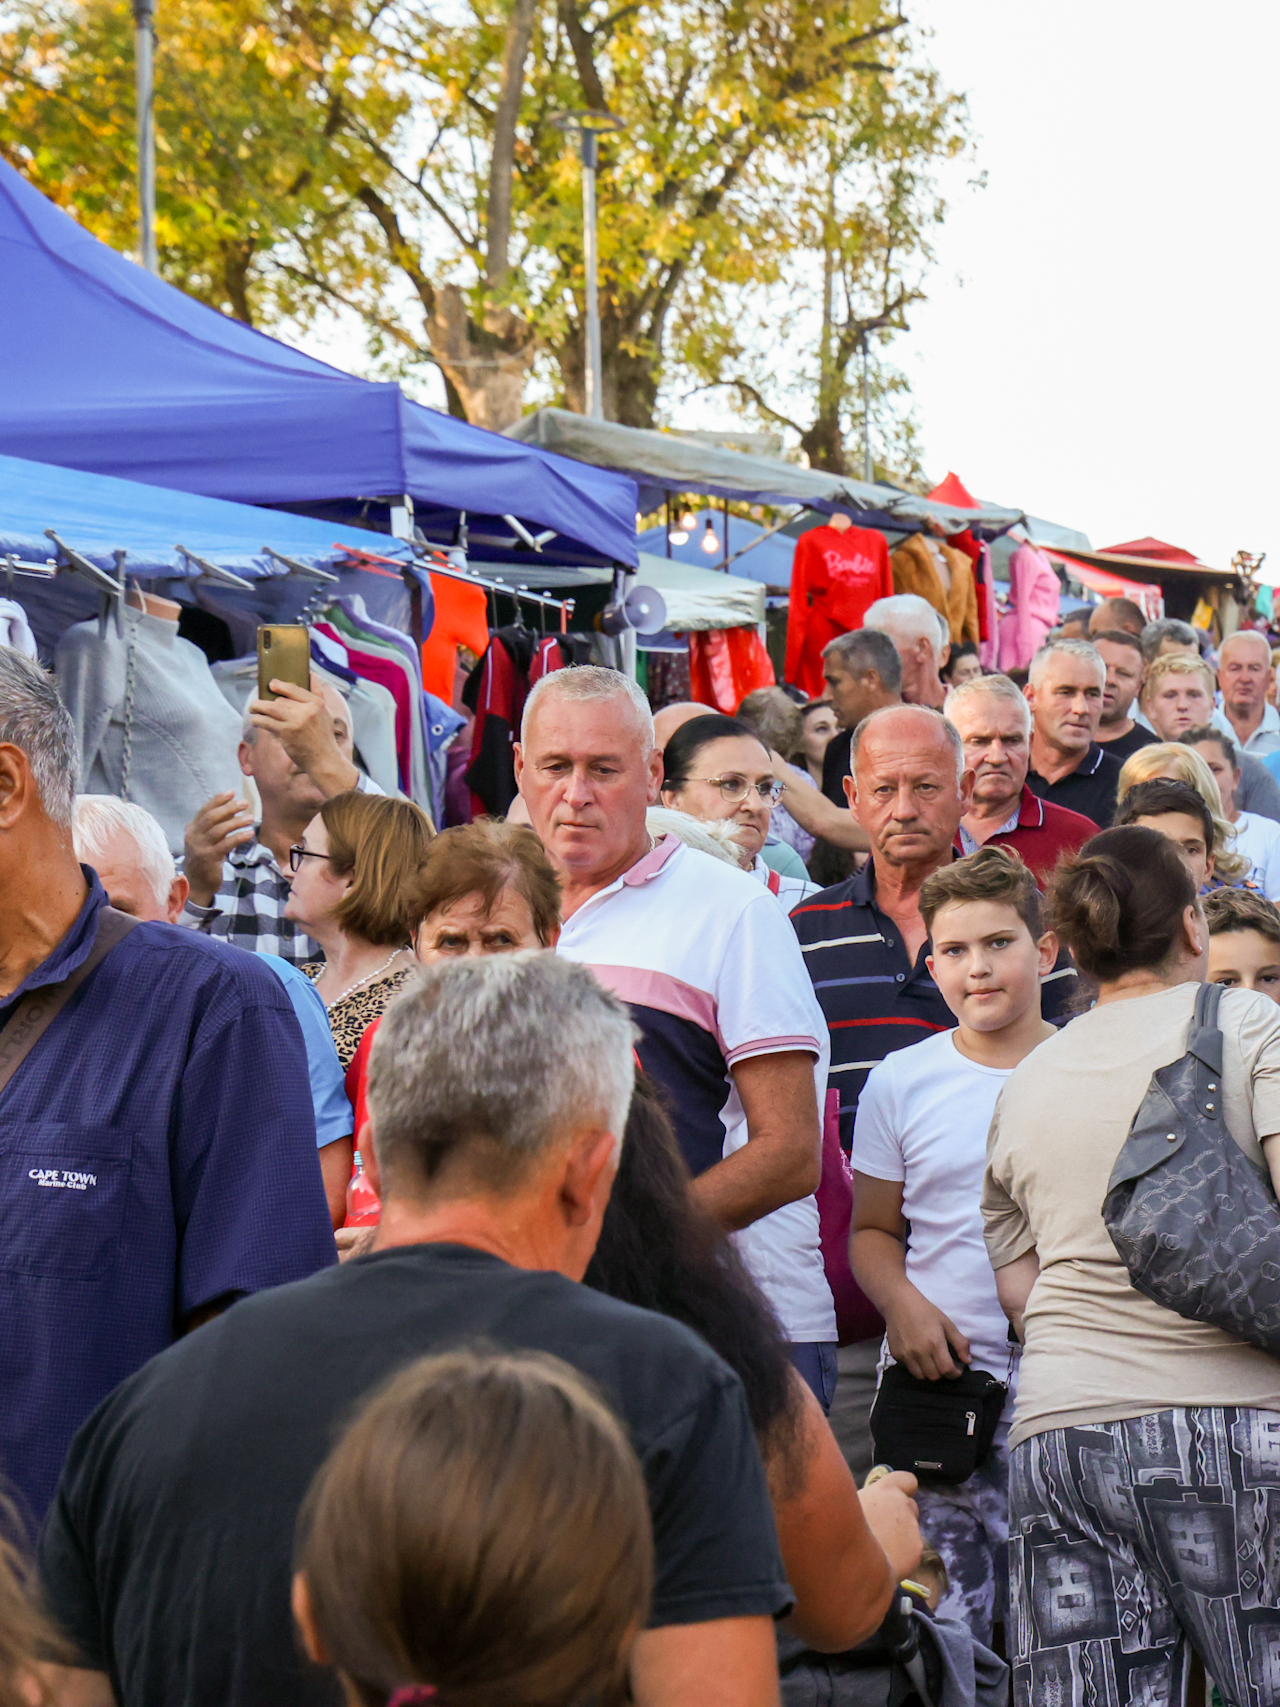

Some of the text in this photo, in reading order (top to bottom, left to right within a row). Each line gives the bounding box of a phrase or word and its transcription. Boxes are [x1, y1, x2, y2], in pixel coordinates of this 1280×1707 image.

[28, 1169, 97, 1186] CAPE TOWN
[38, 1178, 87, 1190] Marine Club
